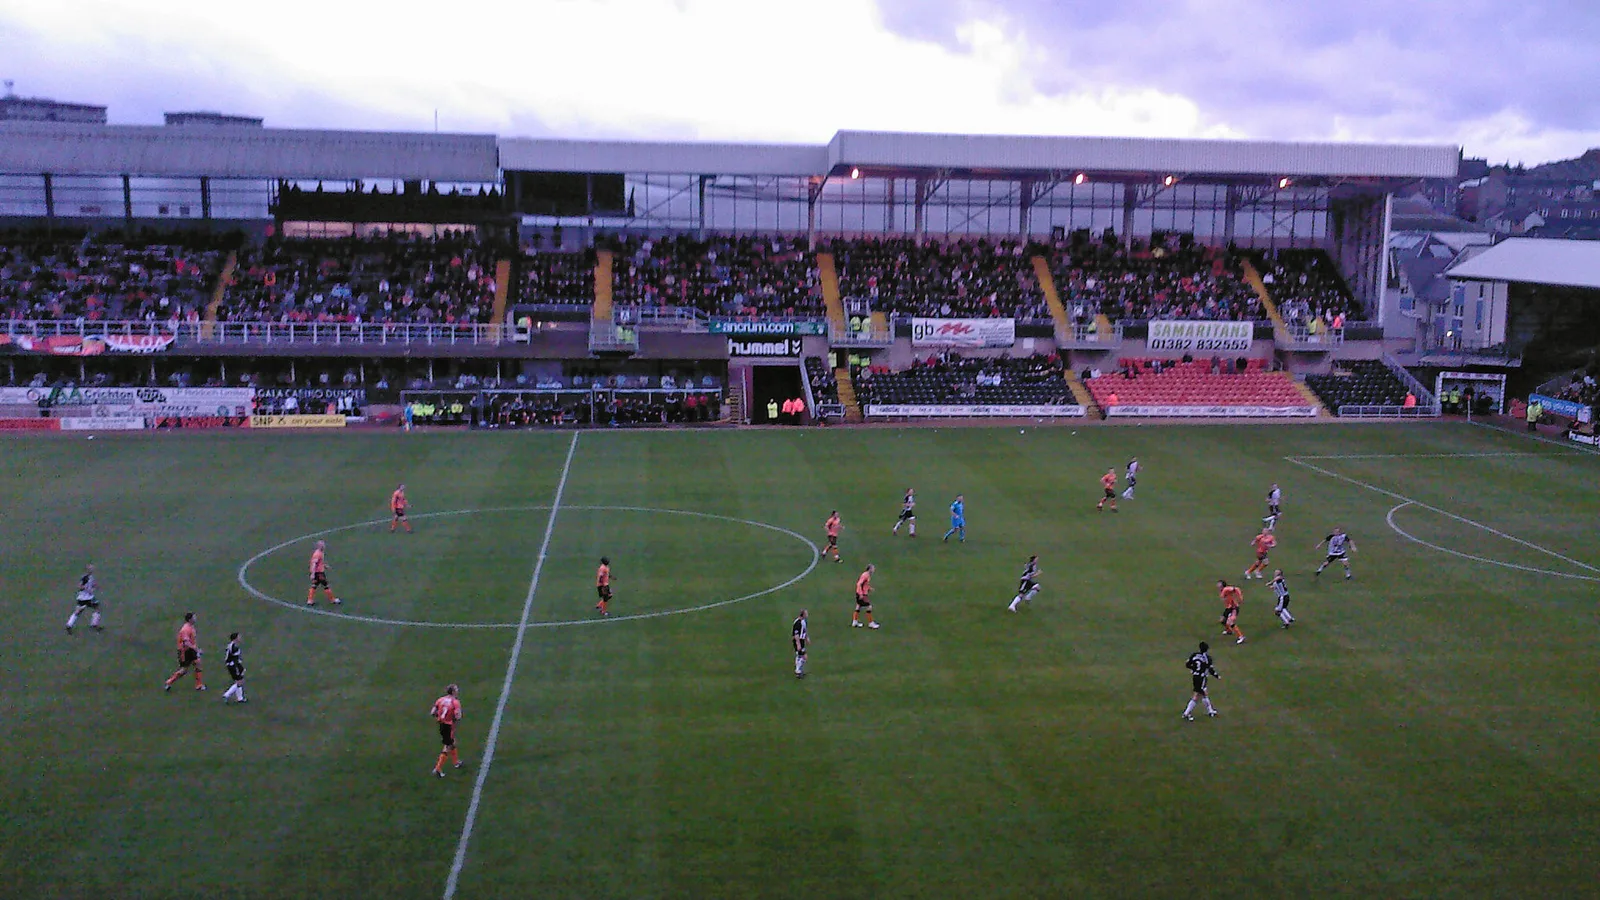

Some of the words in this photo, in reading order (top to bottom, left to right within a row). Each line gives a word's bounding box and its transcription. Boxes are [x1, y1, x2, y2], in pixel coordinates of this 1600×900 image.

[1153, 323, 1248, 337] SAMARITANS
[728, 338, 789, 355] hummel
[1151, 339, 1192, 350] 01382
[1196, 339, 1248, 350] 832555
[253, 416, 272, 426] SNP
